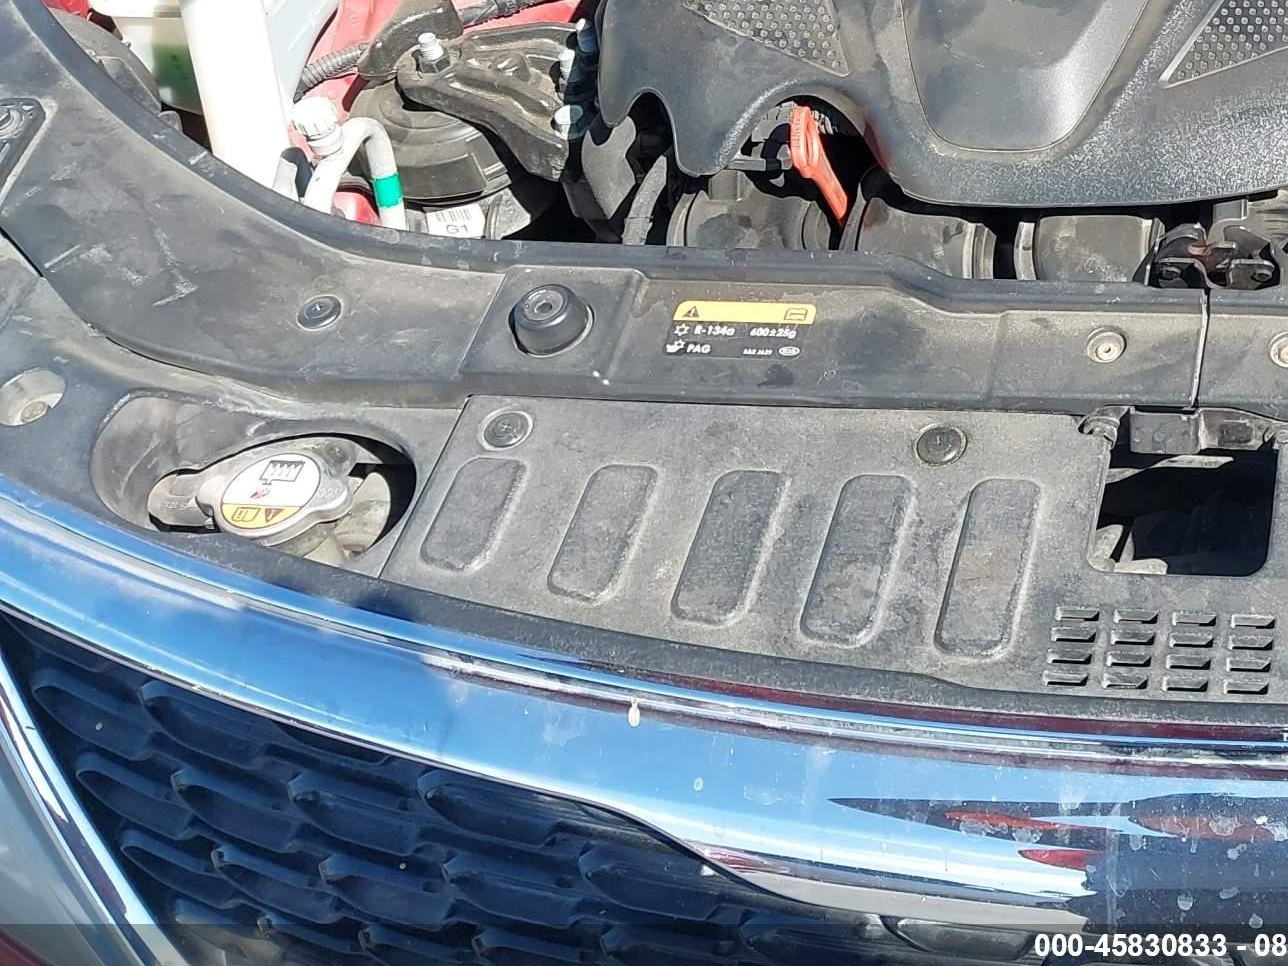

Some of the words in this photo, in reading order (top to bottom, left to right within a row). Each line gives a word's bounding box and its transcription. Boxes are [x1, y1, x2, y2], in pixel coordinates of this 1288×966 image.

[693, 325, 736, 337] R-134a
[749, 326, 798, 339] 600±25g
[686, 344, 712, 354] PAG
